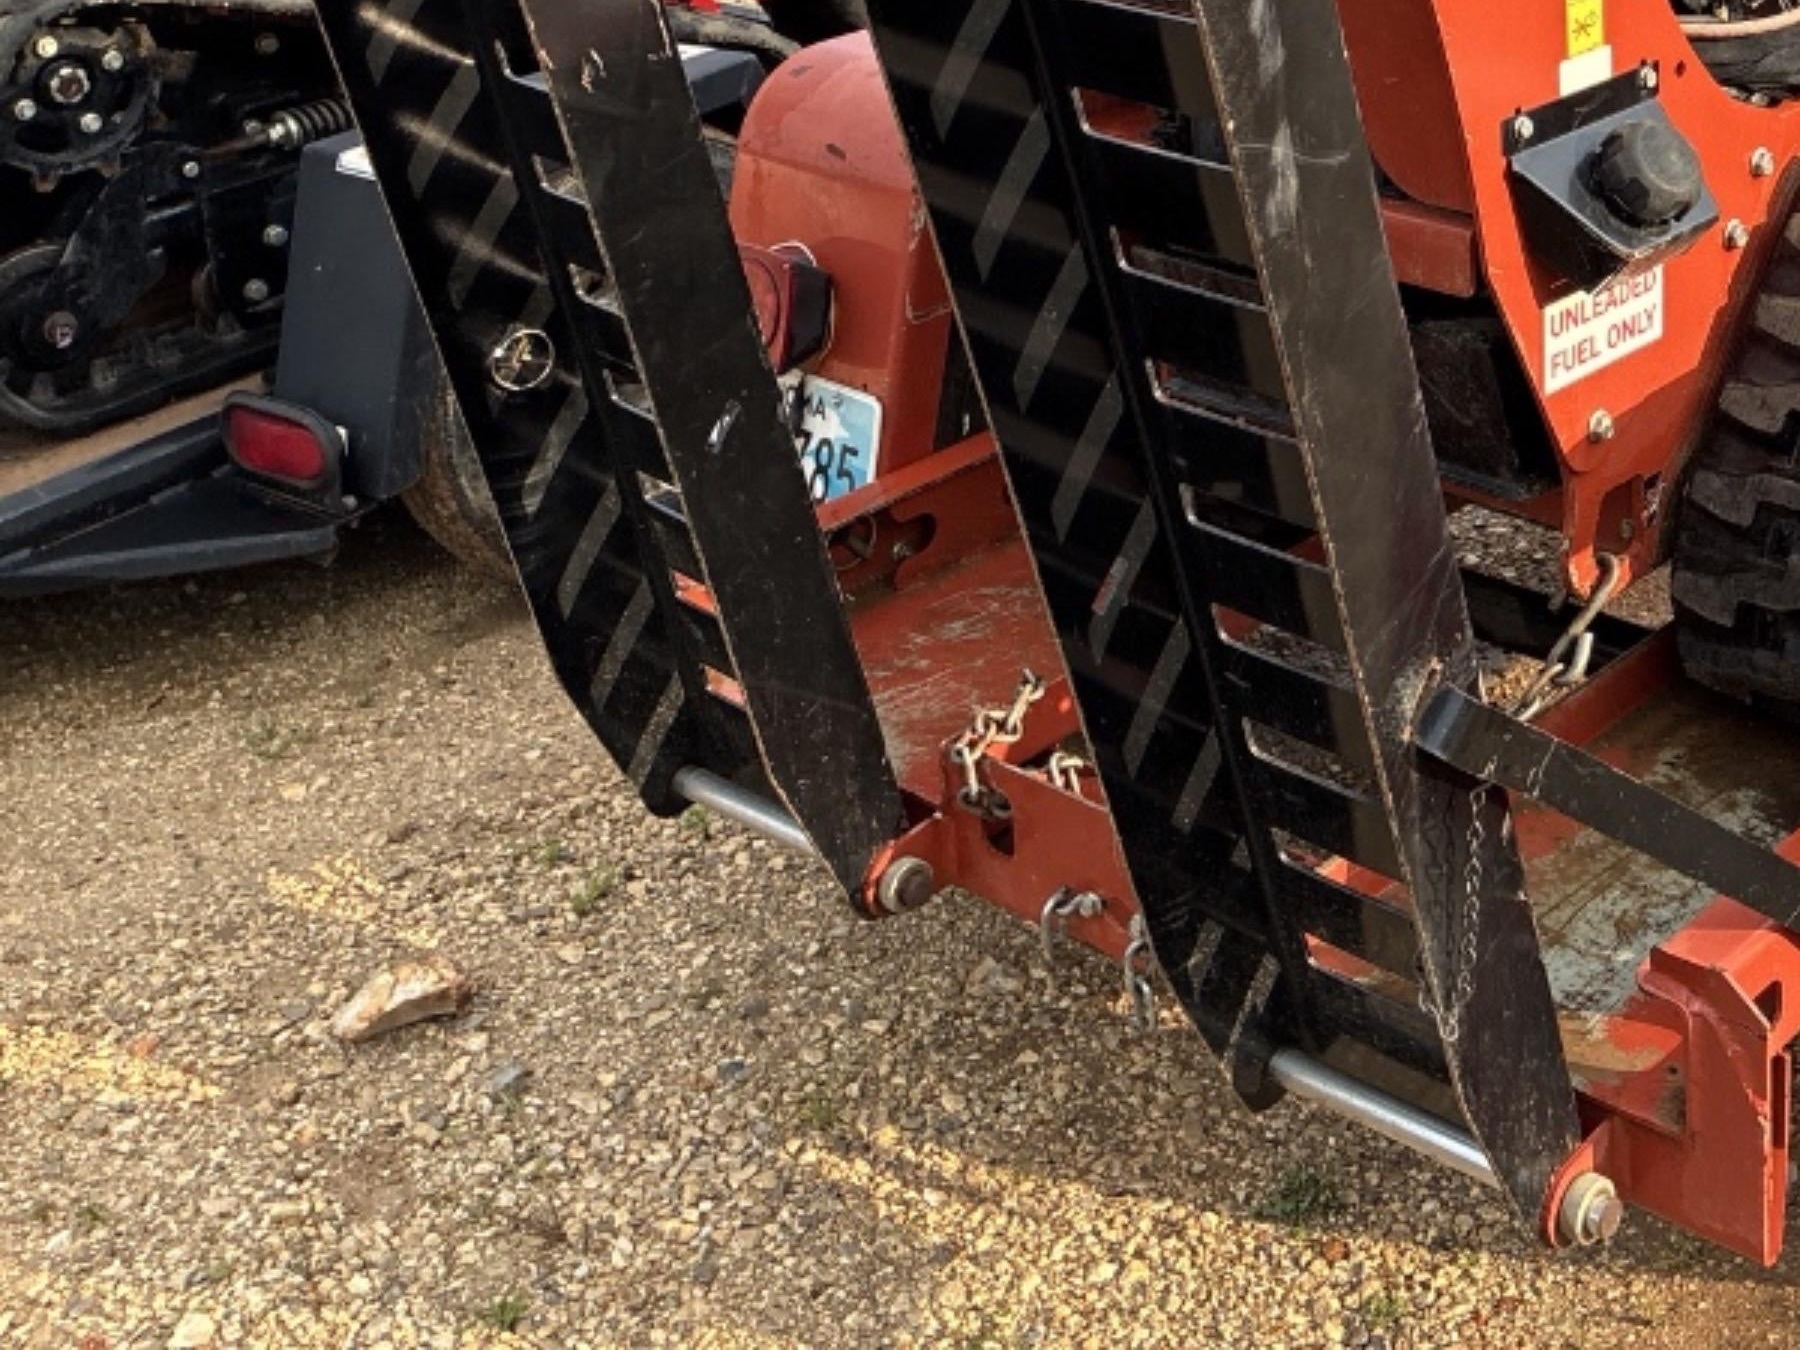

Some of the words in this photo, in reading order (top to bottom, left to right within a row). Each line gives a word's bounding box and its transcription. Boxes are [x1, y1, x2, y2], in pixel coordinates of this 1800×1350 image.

[1550, 270, 1657, 338] UNLEADED
[1550, 334, 1602, 379] FUEL
[1606, 302, 1657, 350] ONLY
